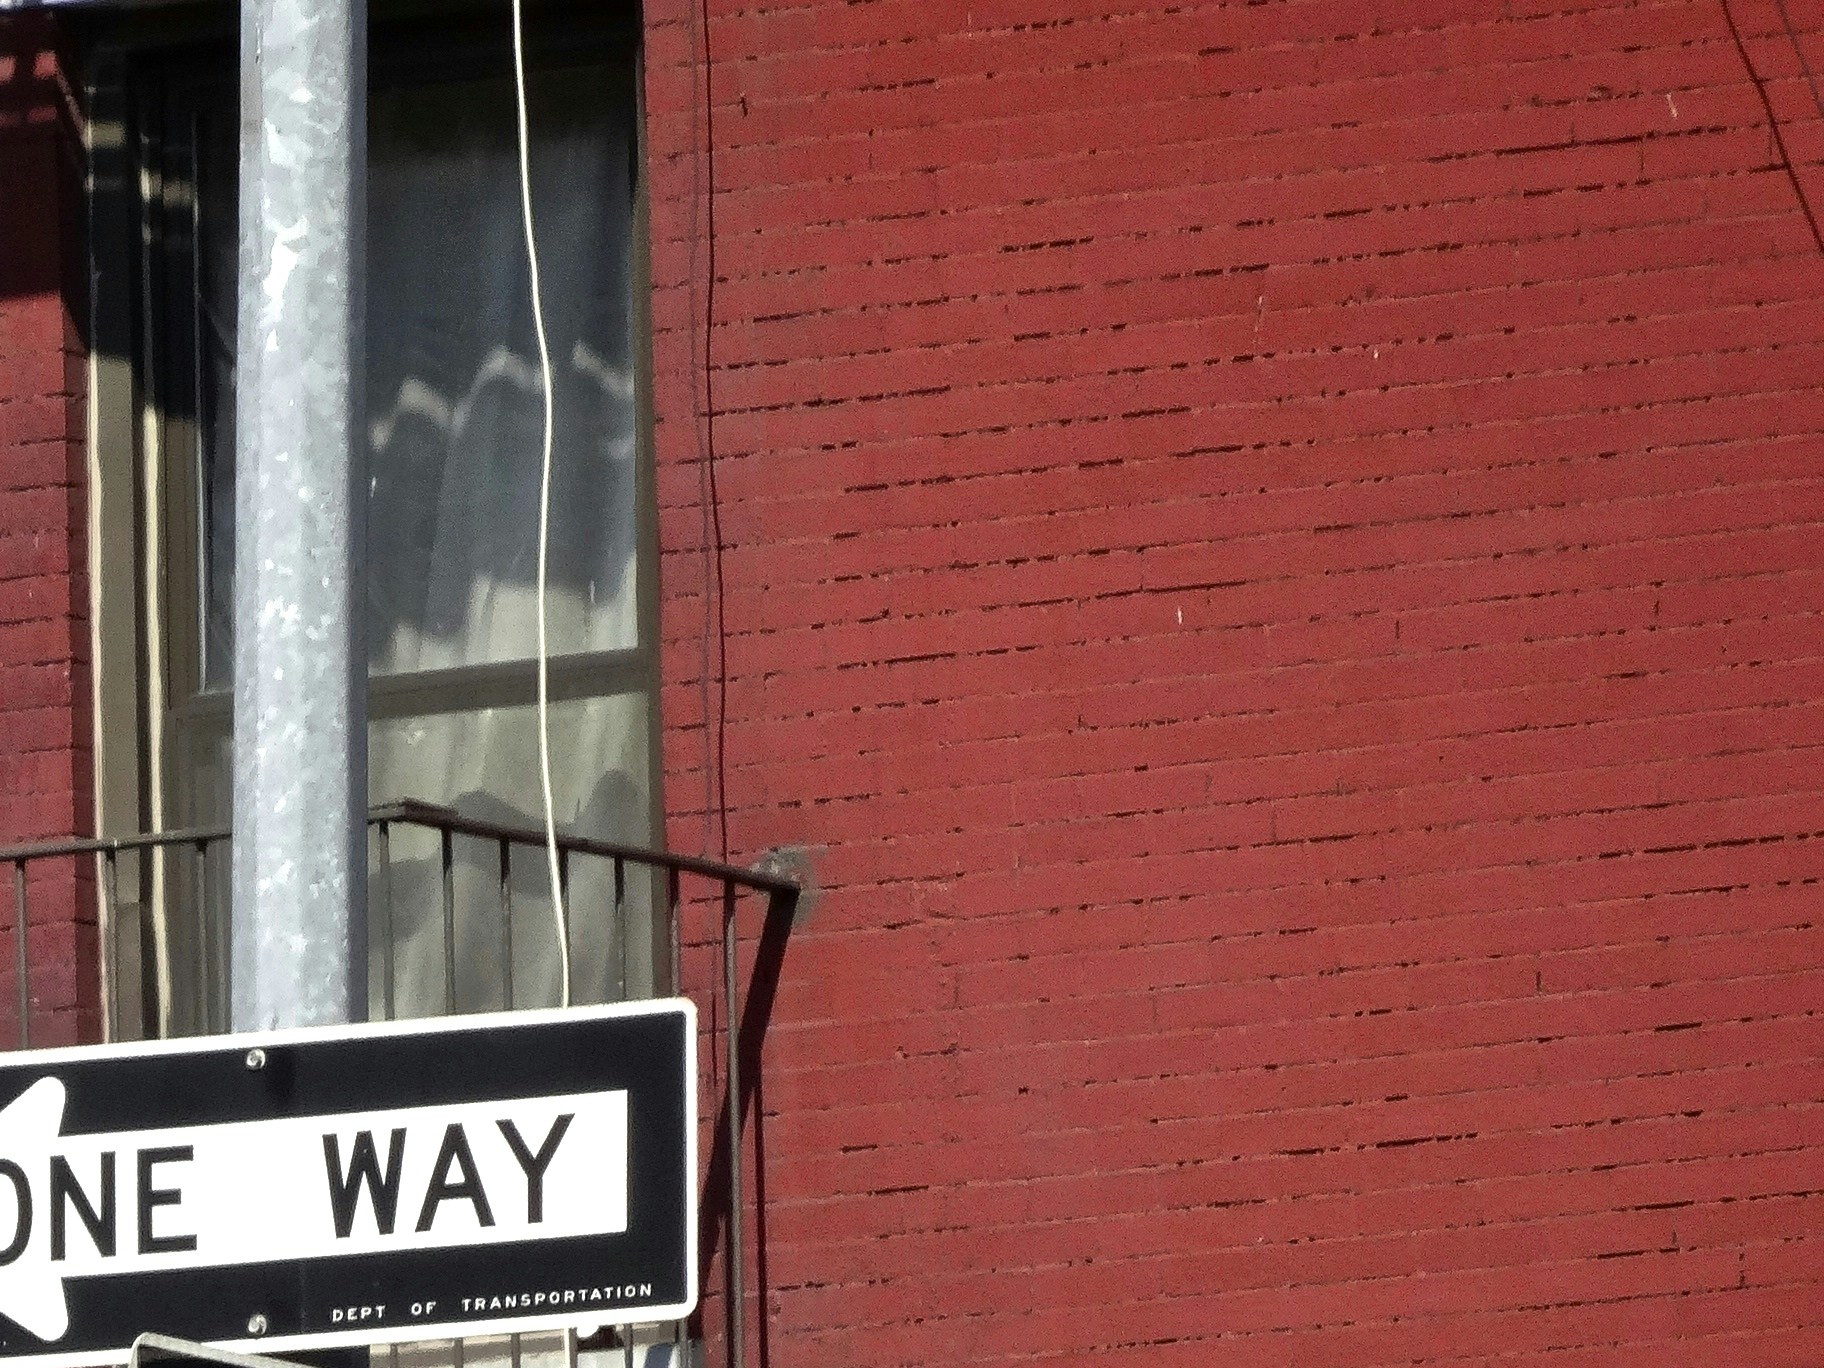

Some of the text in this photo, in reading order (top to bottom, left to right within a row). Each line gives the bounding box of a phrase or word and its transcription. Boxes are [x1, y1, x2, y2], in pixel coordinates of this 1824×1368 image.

[322, 1113, 575, 1239] WAY
[332, 1284, 653, 1323] DEPT OF TRANSPORTATION
